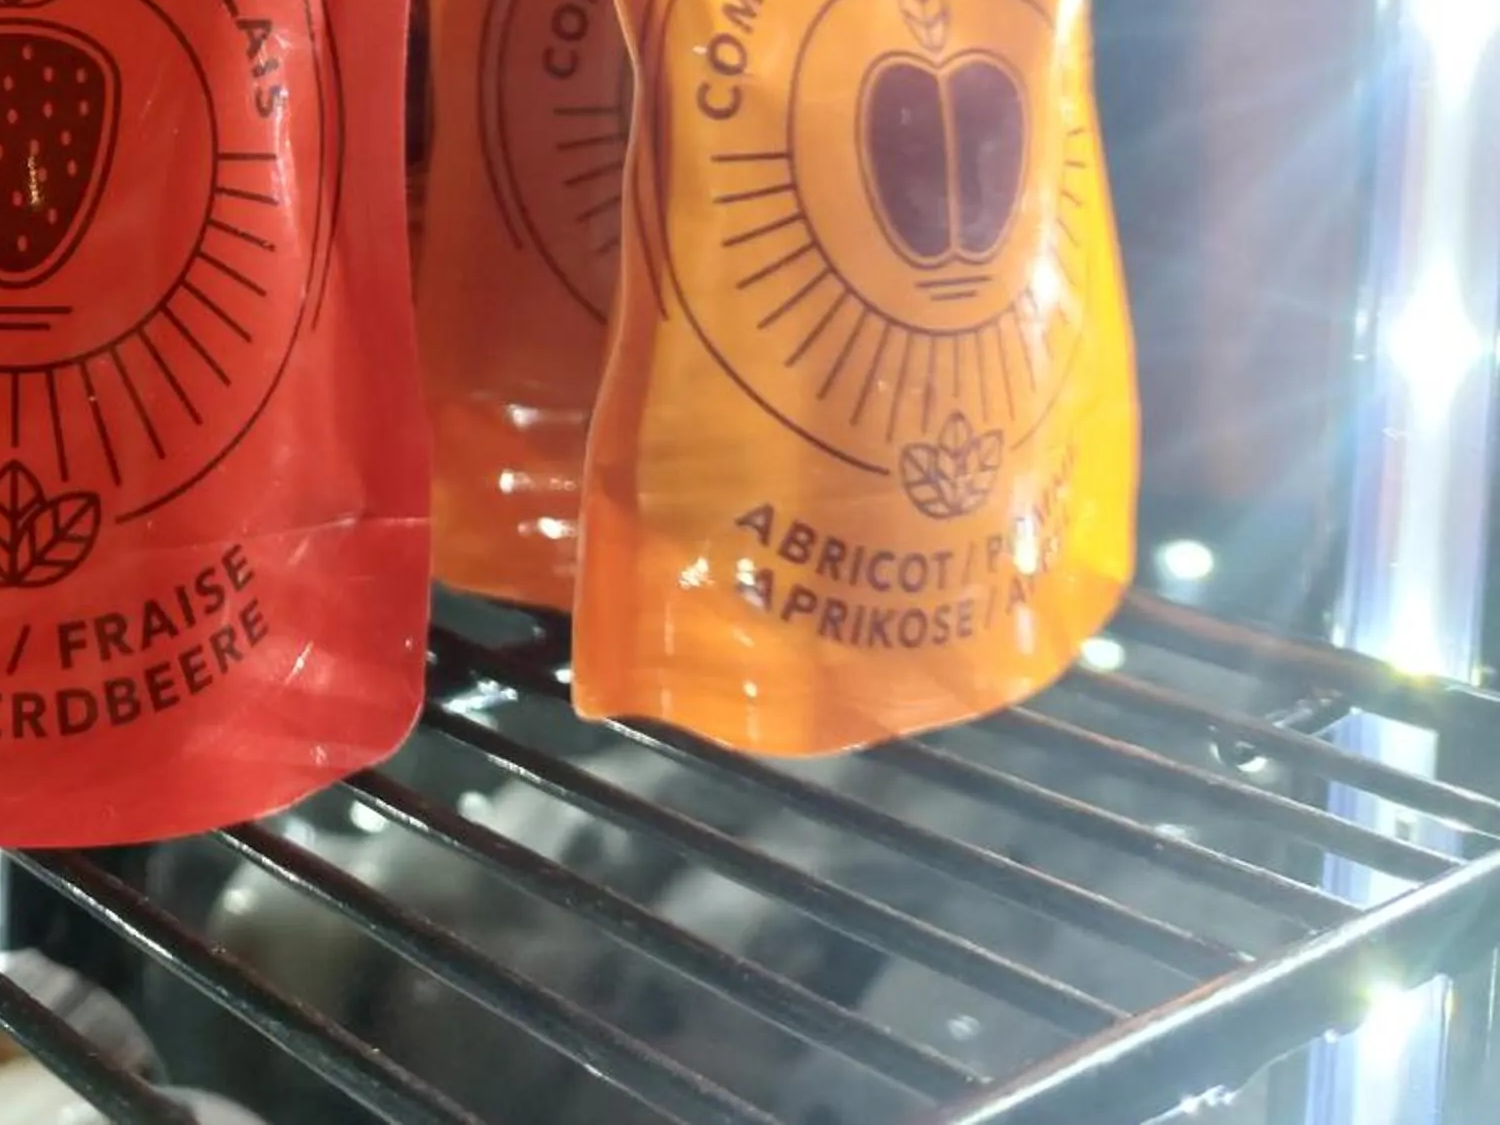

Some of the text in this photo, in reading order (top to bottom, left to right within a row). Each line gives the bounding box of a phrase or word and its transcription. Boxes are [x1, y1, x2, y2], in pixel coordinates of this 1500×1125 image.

[734, 502, 953, 593] ABRICOT
[57, 544, 255, 670] FRAISE
[735, 566, 974, 649] APRIKOSE
